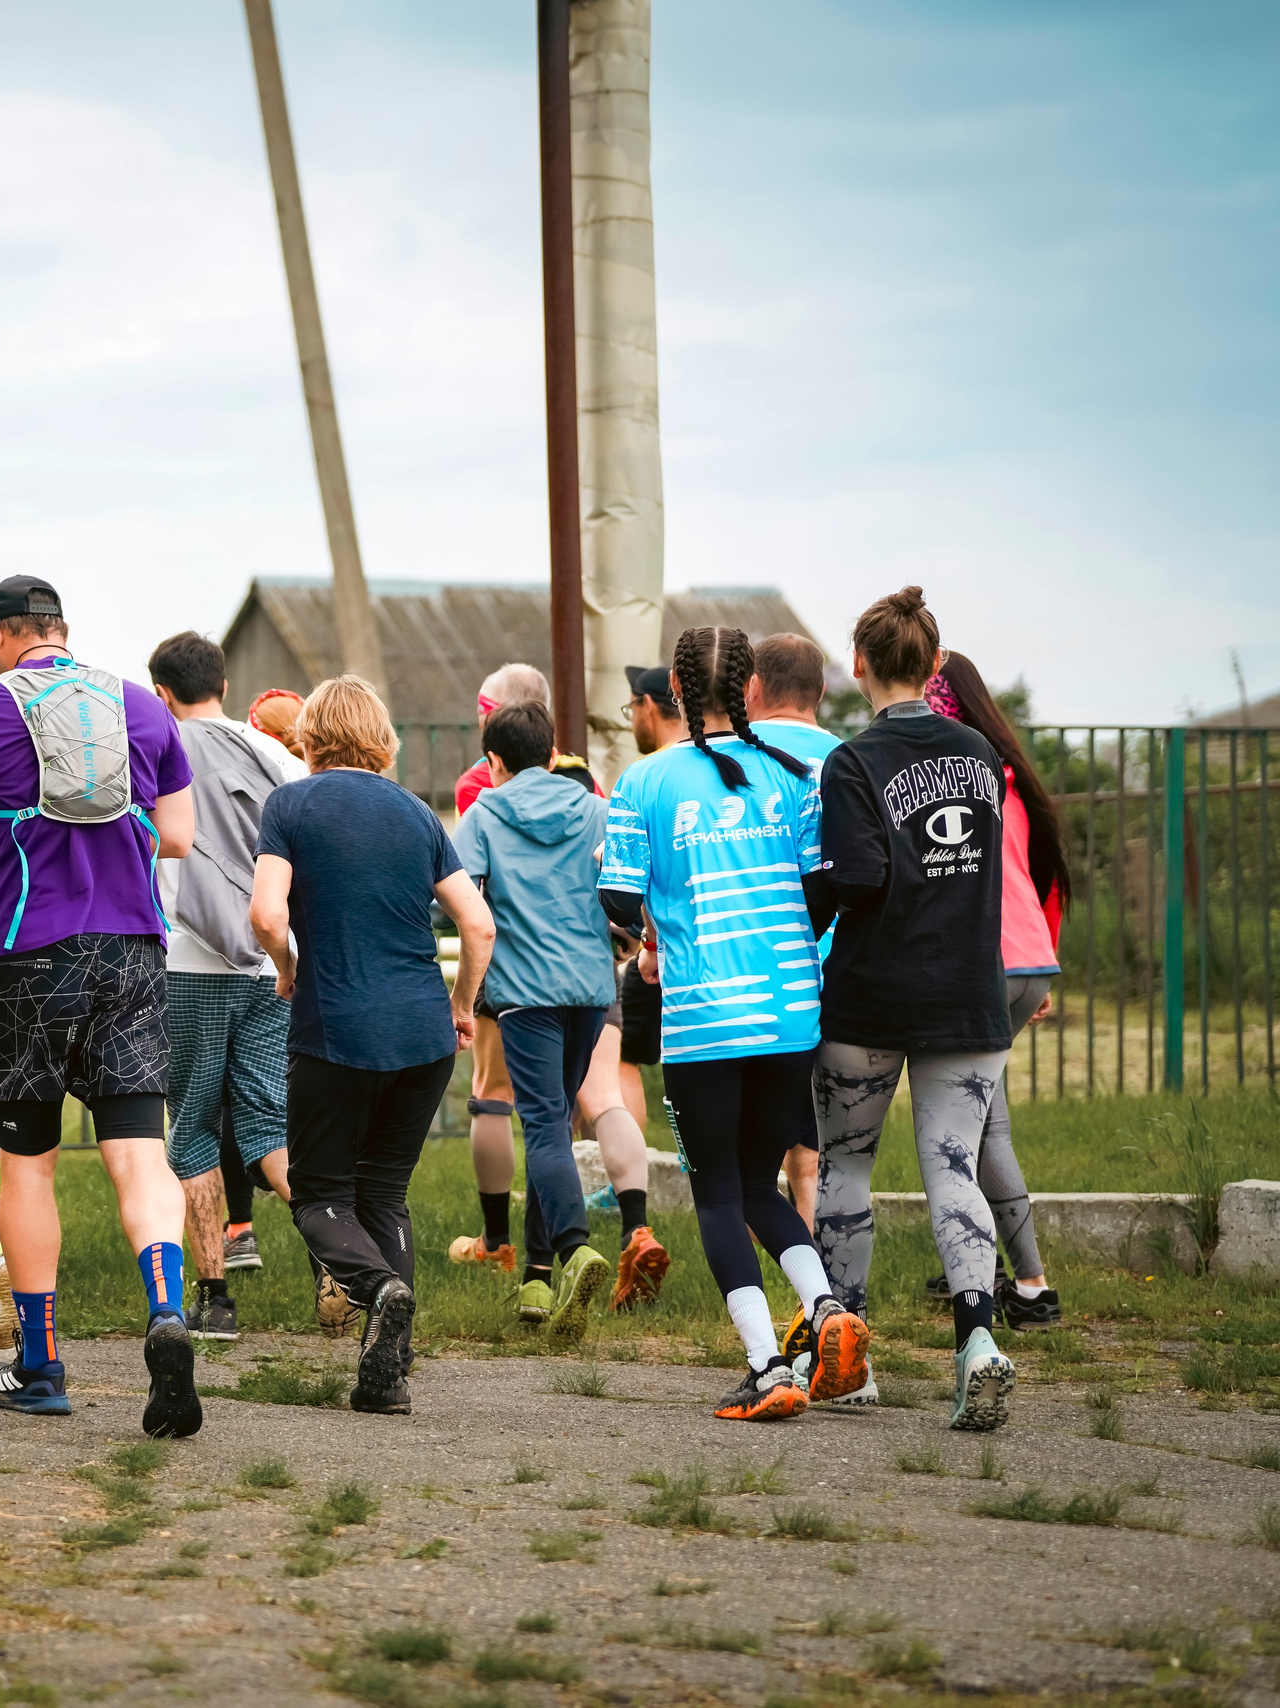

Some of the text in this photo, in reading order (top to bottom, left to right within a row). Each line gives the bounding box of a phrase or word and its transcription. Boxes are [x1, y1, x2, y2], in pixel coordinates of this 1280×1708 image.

[77, 701, 93, 738] Wolf's
[898, 705, 917, 714] NIKE
[883, 757, 1001, 830] CHAMPION
[927, 867, 943, 877] EST
[961, 864, 979, 873] NYC
